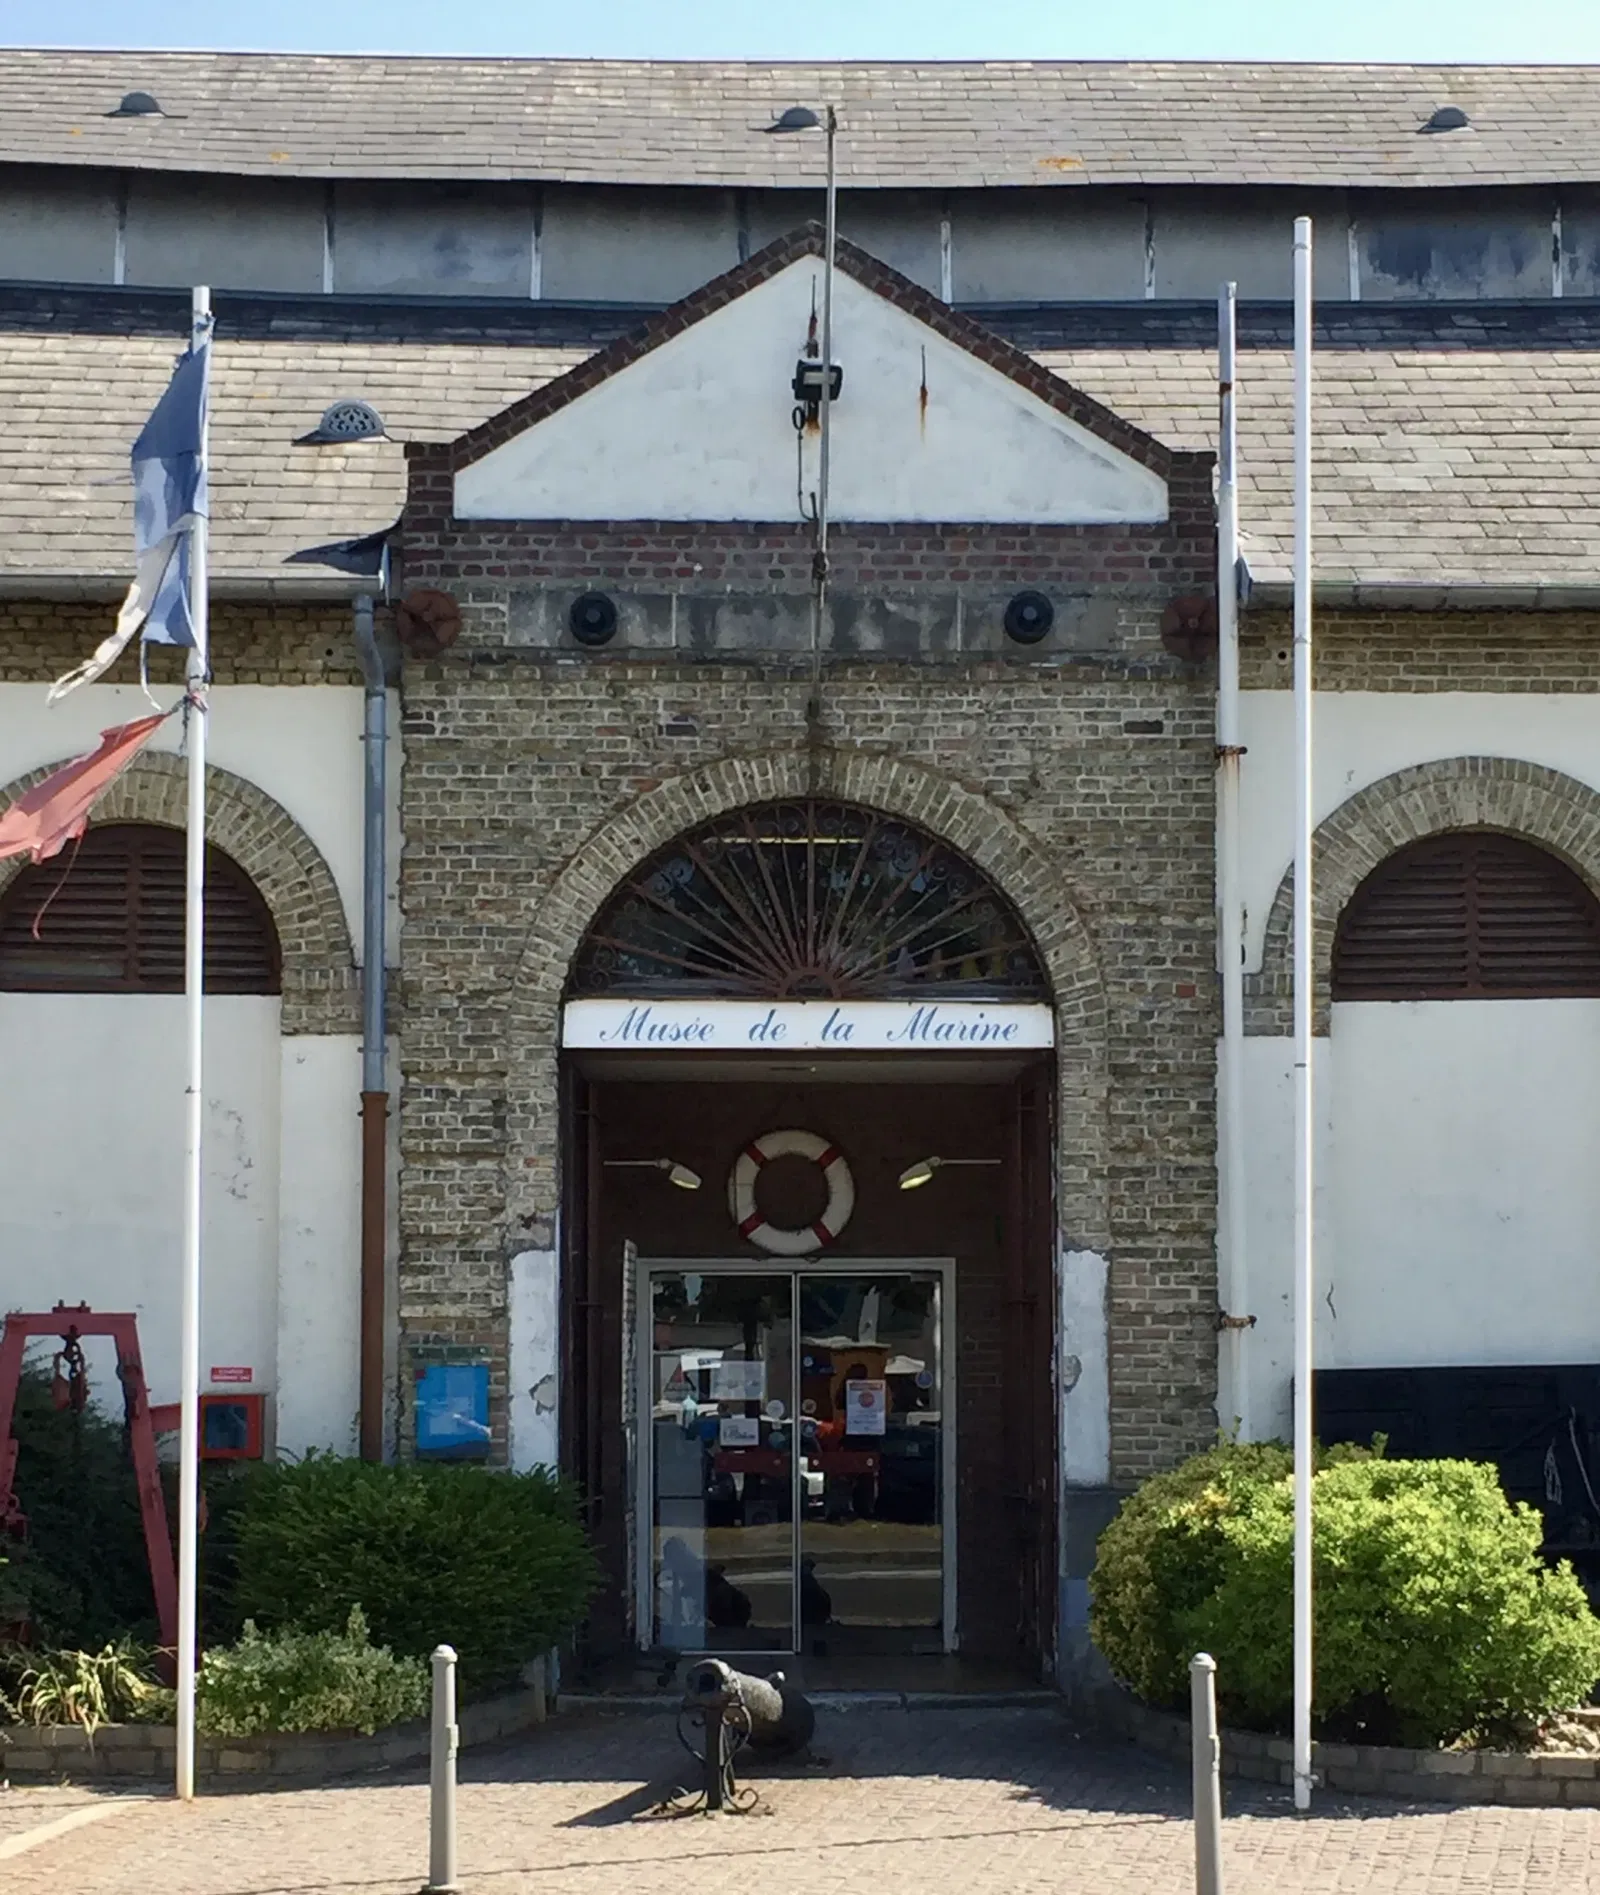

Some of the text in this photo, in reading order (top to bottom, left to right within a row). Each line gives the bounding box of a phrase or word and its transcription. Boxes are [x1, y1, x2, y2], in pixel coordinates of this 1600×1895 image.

[599, 1006, 1019, 1042] Musée de la Marine
